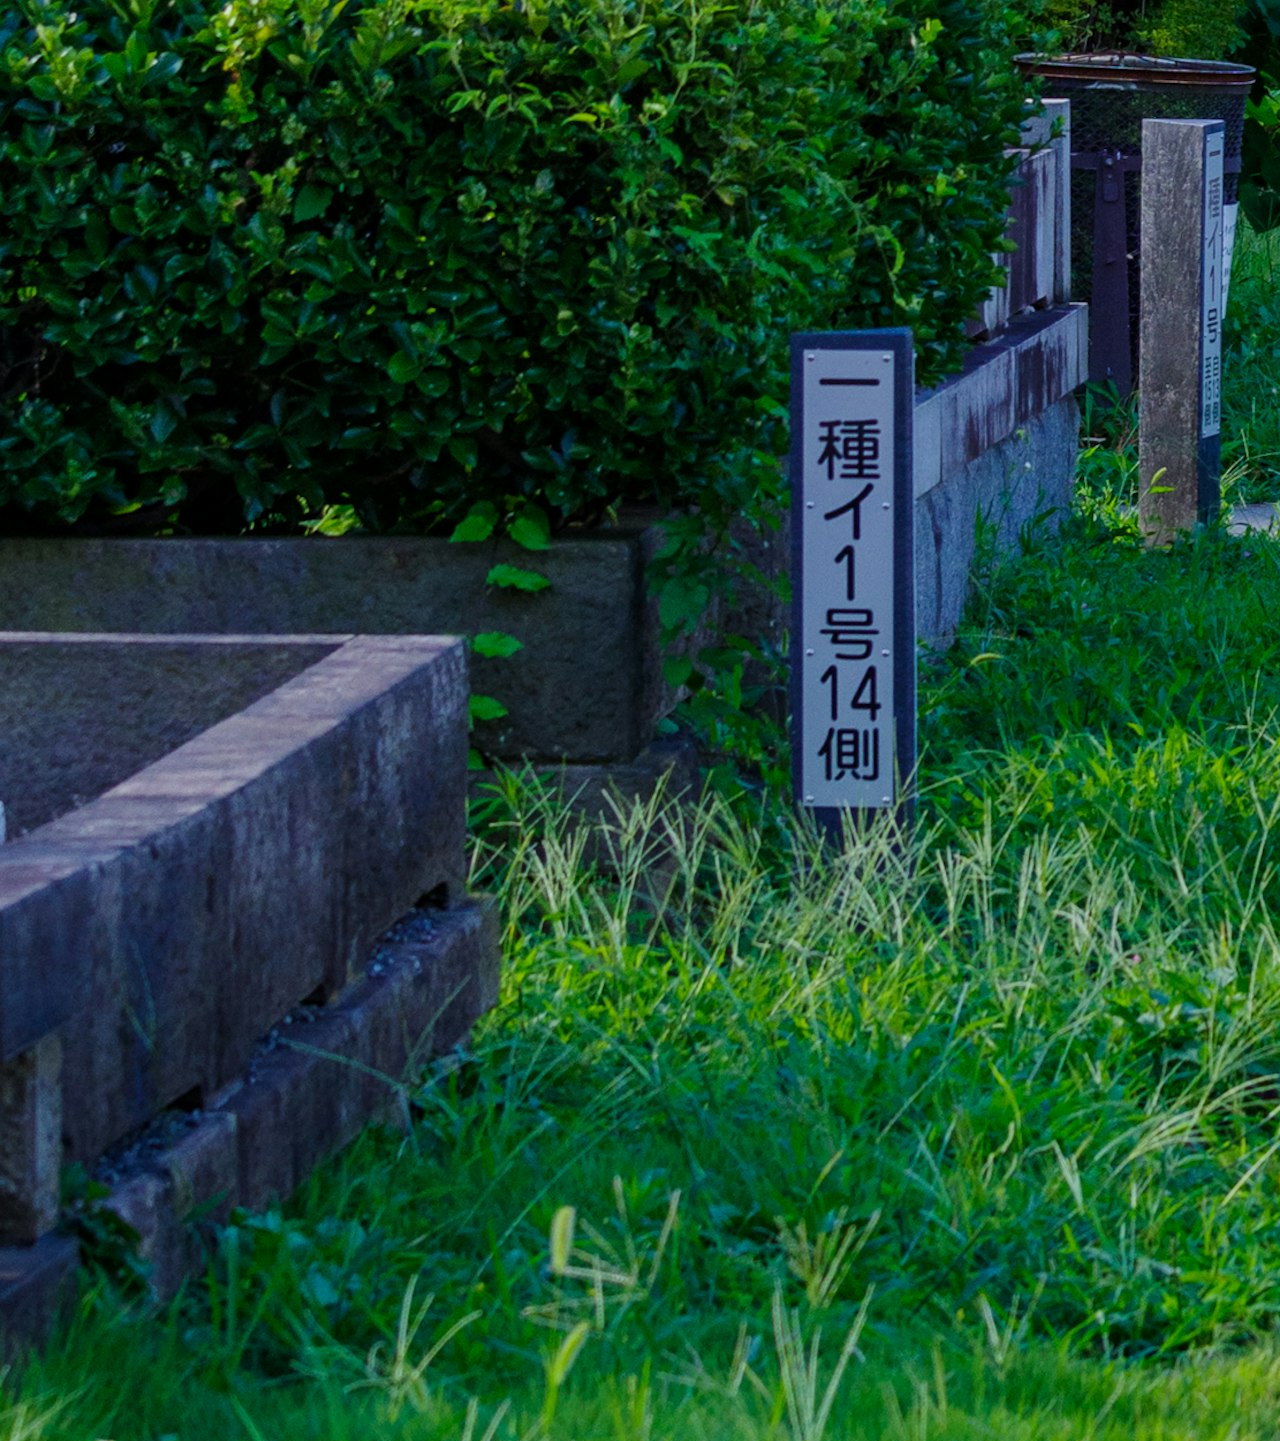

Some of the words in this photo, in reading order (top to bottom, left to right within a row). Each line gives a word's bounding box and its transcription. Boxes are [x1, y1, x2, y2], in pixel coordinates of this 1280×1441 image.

[1207, 150, 1221, 344] 一種イ1号
[817, 378, 882, 781] 一種イ1号14側
